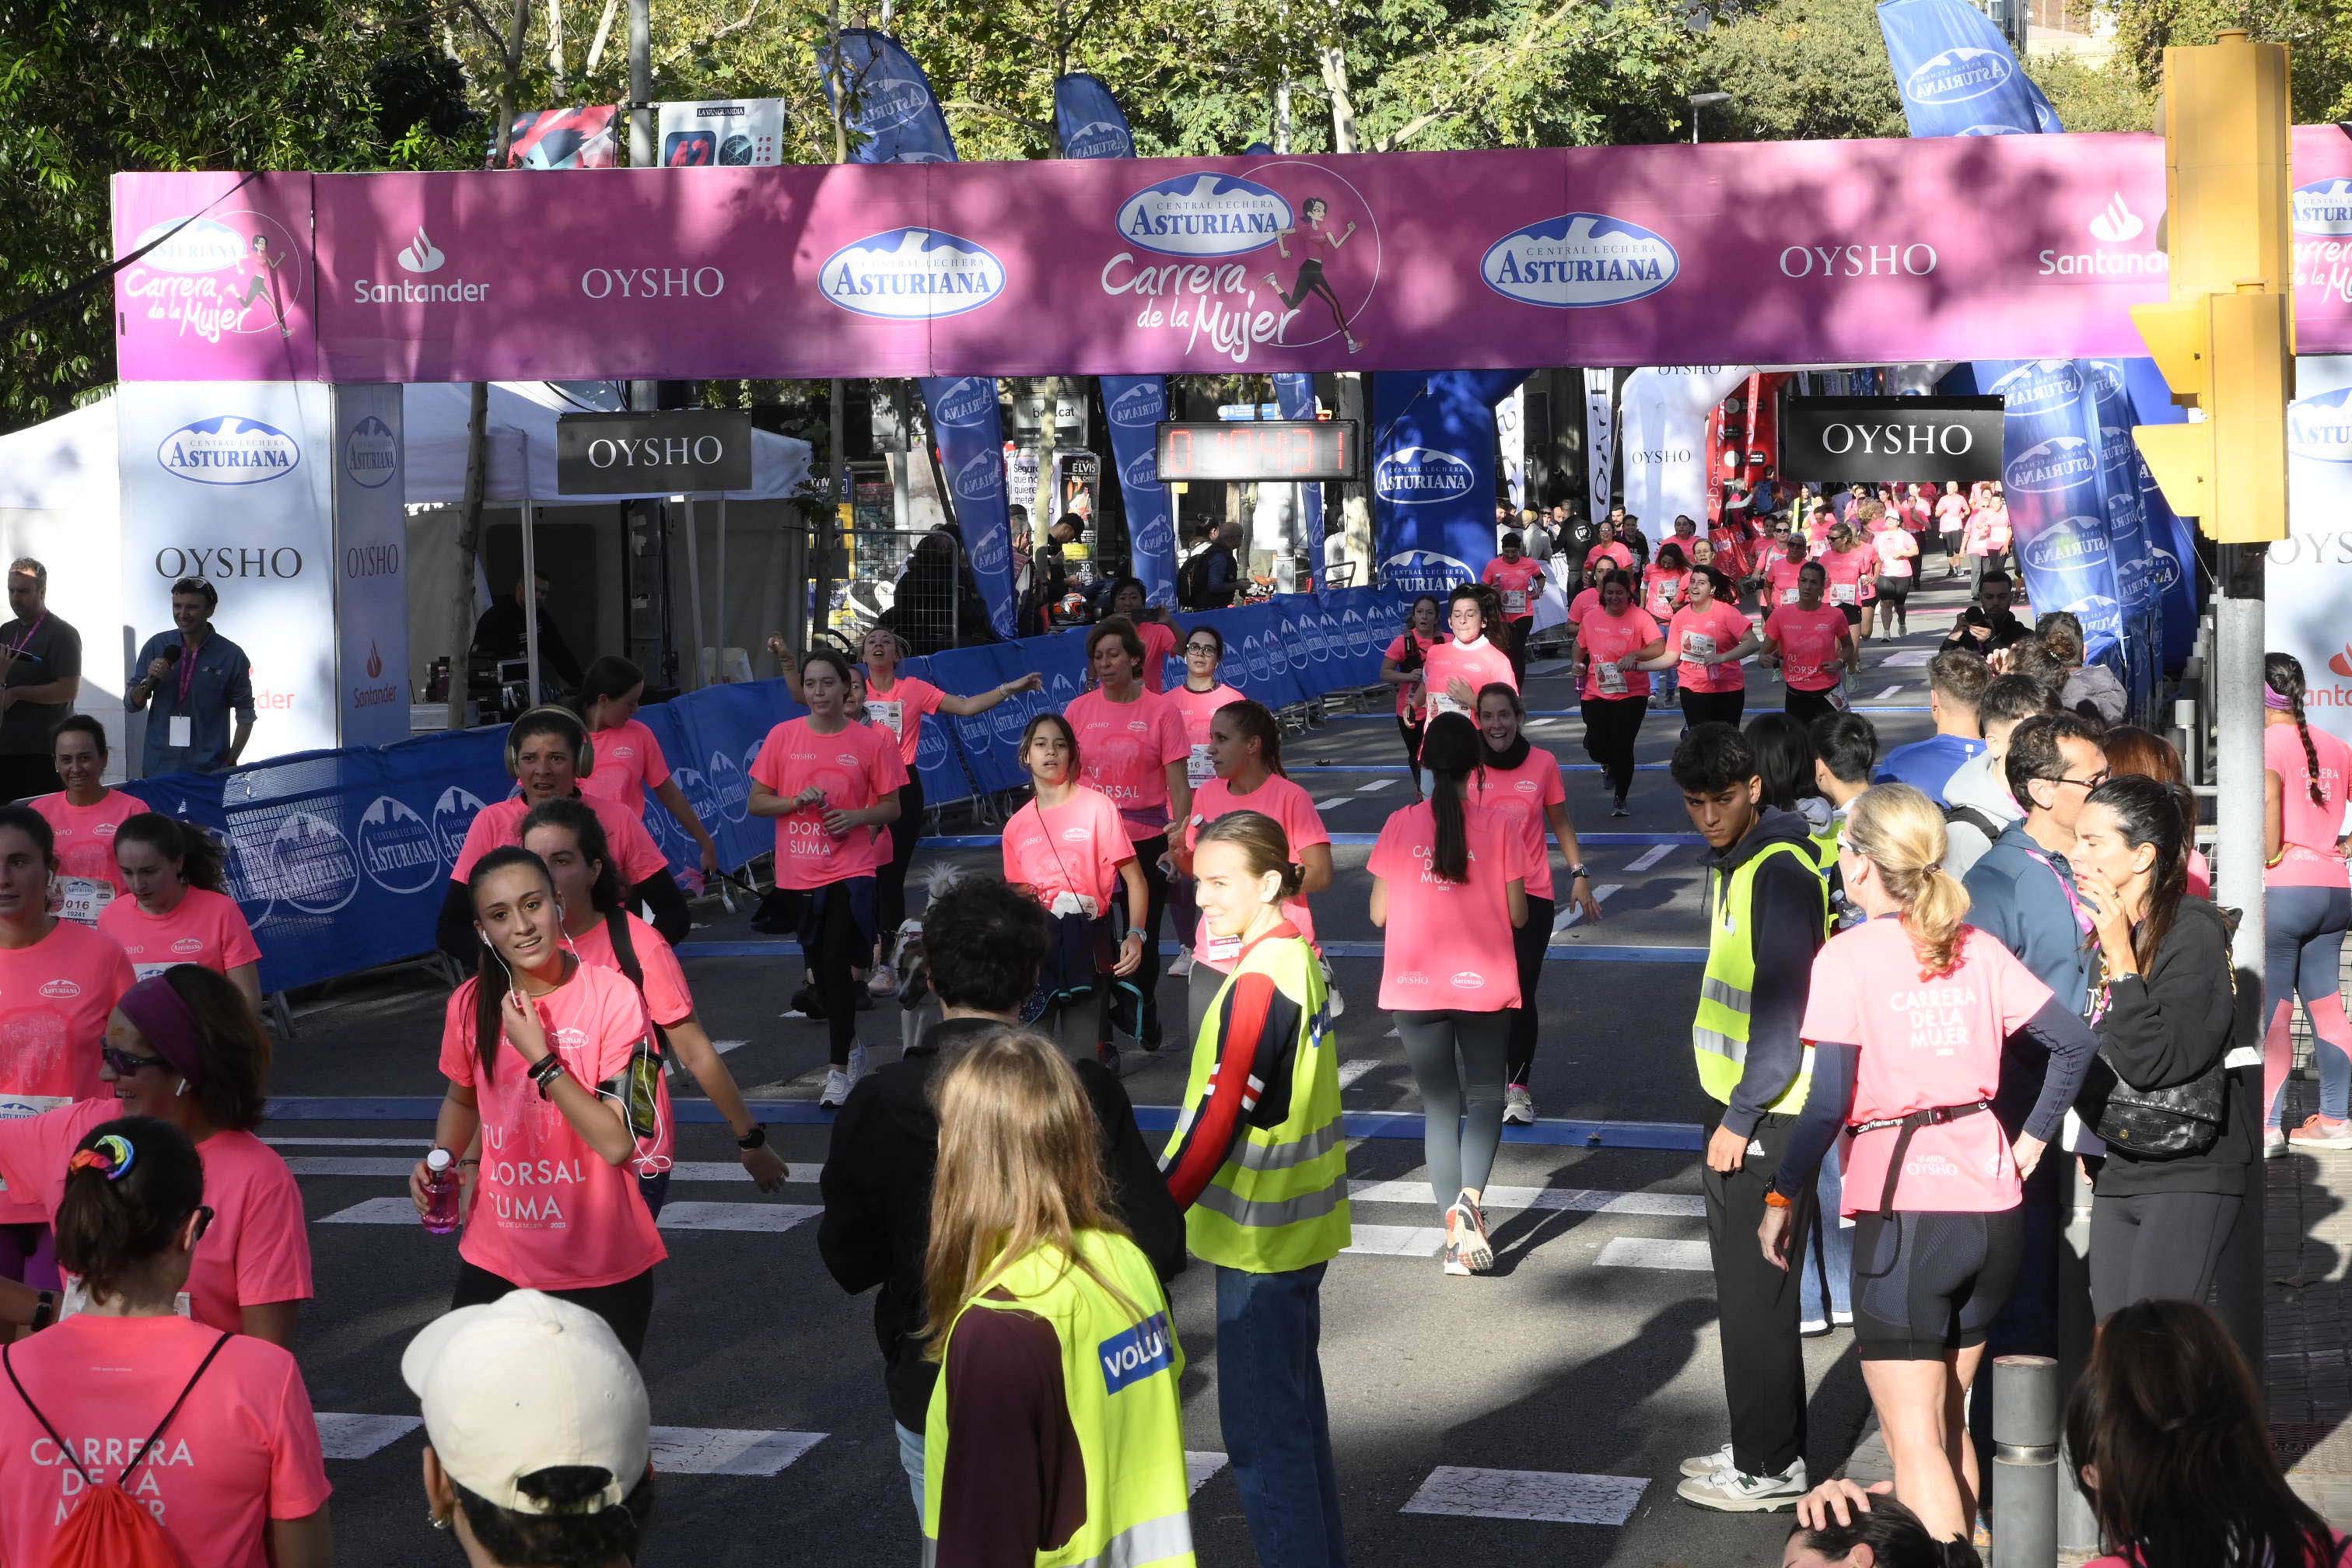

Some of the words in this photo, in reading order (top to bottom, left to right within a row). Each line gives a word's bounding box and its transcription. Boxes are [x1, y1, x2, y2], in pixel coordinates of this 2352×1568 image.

[705, 107, 744, 116] VANGUARDIA
[1157, 200, 1214, 210] CENTRAL
[1219, 199, 1274, 209] LECHERA
[2293, 199, 2352, 222] STURI
[1130, 205, 1280, 236] ASTURIANA
[861, 258, 922, 268] CENTRAL
[926, 257, 985, 268] LECHERA
[1526, 245, 1588, 257] CENTRAL
[1593, 244, 1657, 257] LECHERA
[1780, 243, 1937, 278] OYSHO
[2039, 248, 2168, 275] Santand
[833, 262, 992, 296] ASTURIANA
[1101, 252, 1247, 296] Carrera
[1495, 249, 1664, 284] ASTURIANA
[124, 268, 218, 298] Carrera
[354, 279, 490, 303] Santander
[582, 266, 725, 299] OYSHO
[148, 299, 166, 319] de
[168, 299, 181, 319] la
[179, 293, 253, 343] Mujer
[1137, 299, 1167, 328] de
[1169, 300, 1190, 328] la
[1185, 291, 1301, 363] Mujer
[238, 439, 285, 447] LECHERA
[1822, 422, 1973, 455] OYSHO
[168, 441, 290, 467] ASTURIANA
[350, 442, 394, 471] ASTURIANA
[588, 435, 723, 468] OYSHO
[1632, 448, 1692, 466] OYSHO
[1072, 463, 1096, 473] ELVIS
[1379, 469, 1468, 492] ASTURIANA
[1013, 477, 1027, 485] que
[1014, 488, 1038, 502] quiere
[348, 543, 399, 579] OYSHO
[2268, 534, 2352, 565] OYS
[155, 547, 303, 579] OYSHO
[1080, 563, 1090, 572] 30
[1788, 665, 1818, 674] DORSA
[354, 684, 397, 709] Santander
[365, 836, 437, 873] ASTURIANA
[789, 840, 831, 855] SUMA
[65, 900, 89, 910] 016
[124, 945, 144, 954] SHO
[173, 943, 202, 952] ASTURIANA
[42, 985, 79, 995] ASTURIANA
[1397, 976, 1429, 985] OYSHO
[1454, 977, 1482, 985] ASTURIANA
[1890, 986, 1977, 1012] CARRERA
[1911, 1012, 1938, 1029] DE
[1940, 1009, 1964, 1026] LA
[1910, 1027, 1969, 1048] MUJER
[485, 1125, 503, 1150] TU
[488, 1192, 562, 1220] UMA
[30, 1437, 194, 1467] CARRERA
